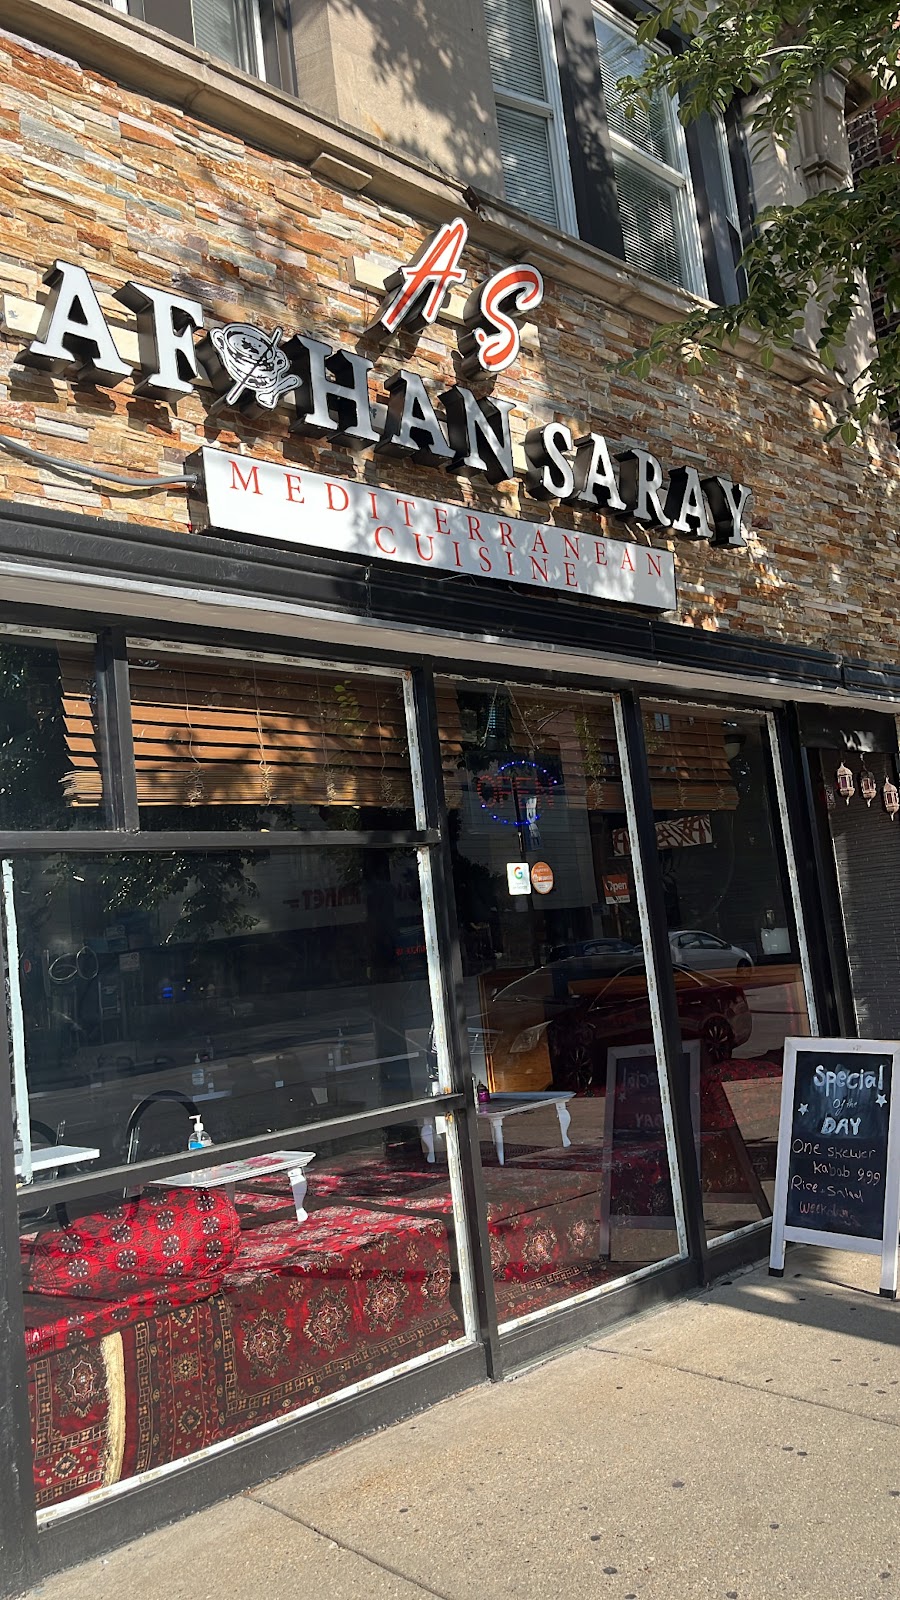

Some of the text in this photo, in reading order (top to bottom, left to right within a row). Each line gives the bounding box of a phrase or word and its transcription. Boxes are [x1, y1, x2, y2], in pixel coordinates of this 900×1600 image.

[542, 422, 752, 548] SARAY
[228, 460, 663, 579] MEDITERRANEAN
[373, 525, 579, 588] CUISINE
[813, 1064, 884, 1097] Special
[820, 1116, 862, 1136] DAY
[791, 1137, 821, 1155] One
[790, 1174, 818, 1193] Rice
